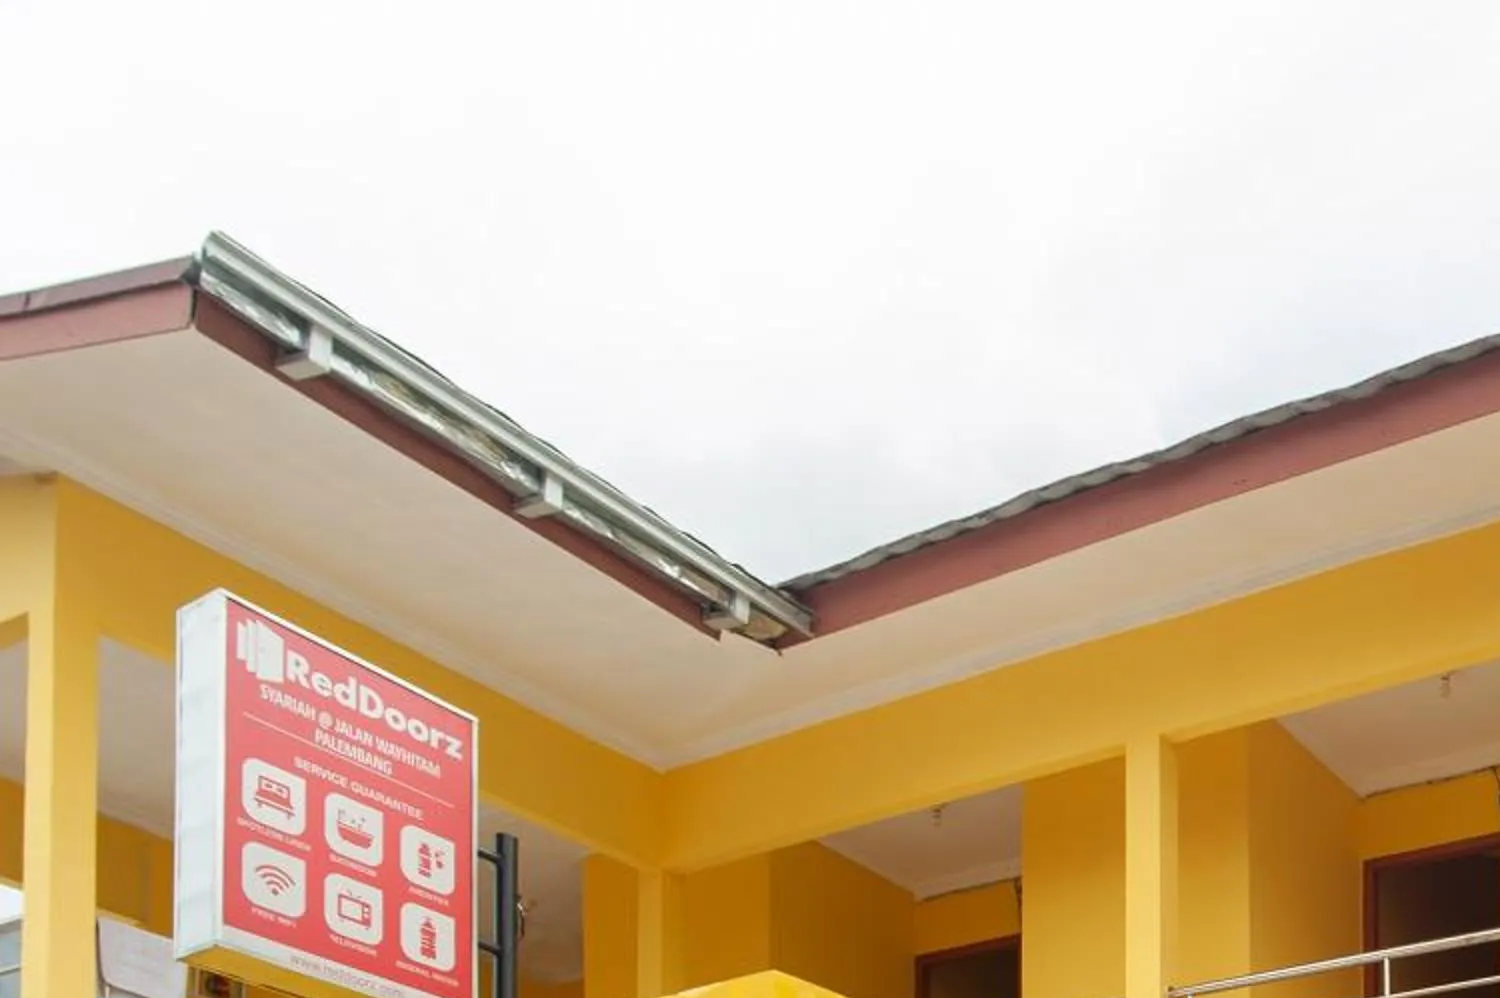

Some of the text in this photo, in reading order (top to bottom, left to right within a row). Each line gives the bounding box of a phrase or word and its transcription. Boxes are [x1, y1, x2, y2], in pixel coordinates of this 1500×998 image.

[260, 684, 316, 722] SYARIAH
[335, 719, 373, 748] JALAN
[286, 650, 463, 760] RedDoorz
[315, 729, 393, 776] PALEMBANG
[293, 756, 424, 821] SERVICE GUARANTEE
